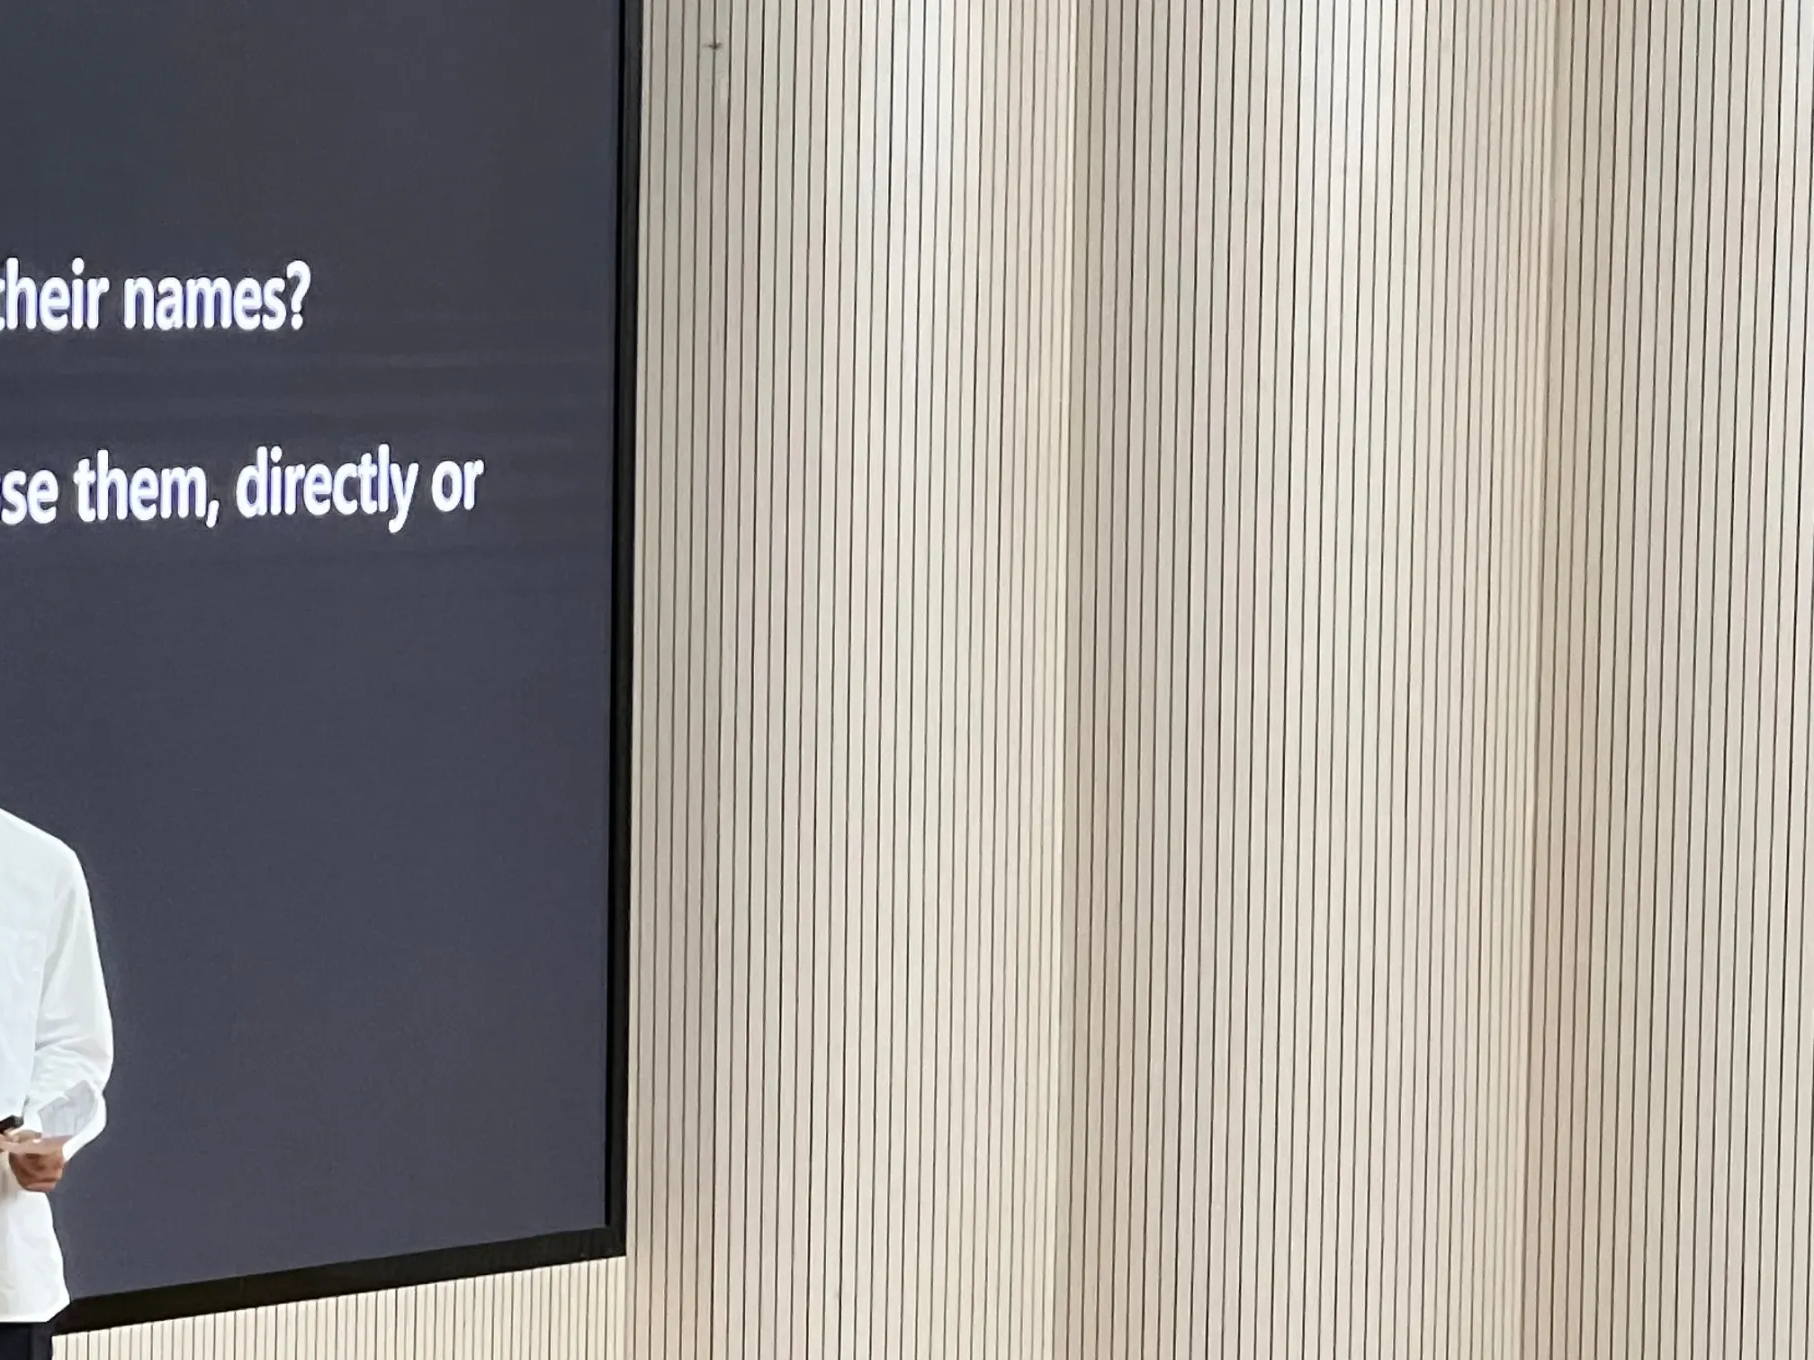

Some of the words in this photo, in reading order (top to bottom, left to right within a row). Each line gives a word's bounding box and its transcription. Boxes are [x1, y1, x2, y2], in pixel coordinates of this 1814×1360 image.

[123, 260, 312, 332] names?
[72, 449, 220, 529] them,
[235, 443, 419, 534] directly
[431, 459, 485, 513] or
